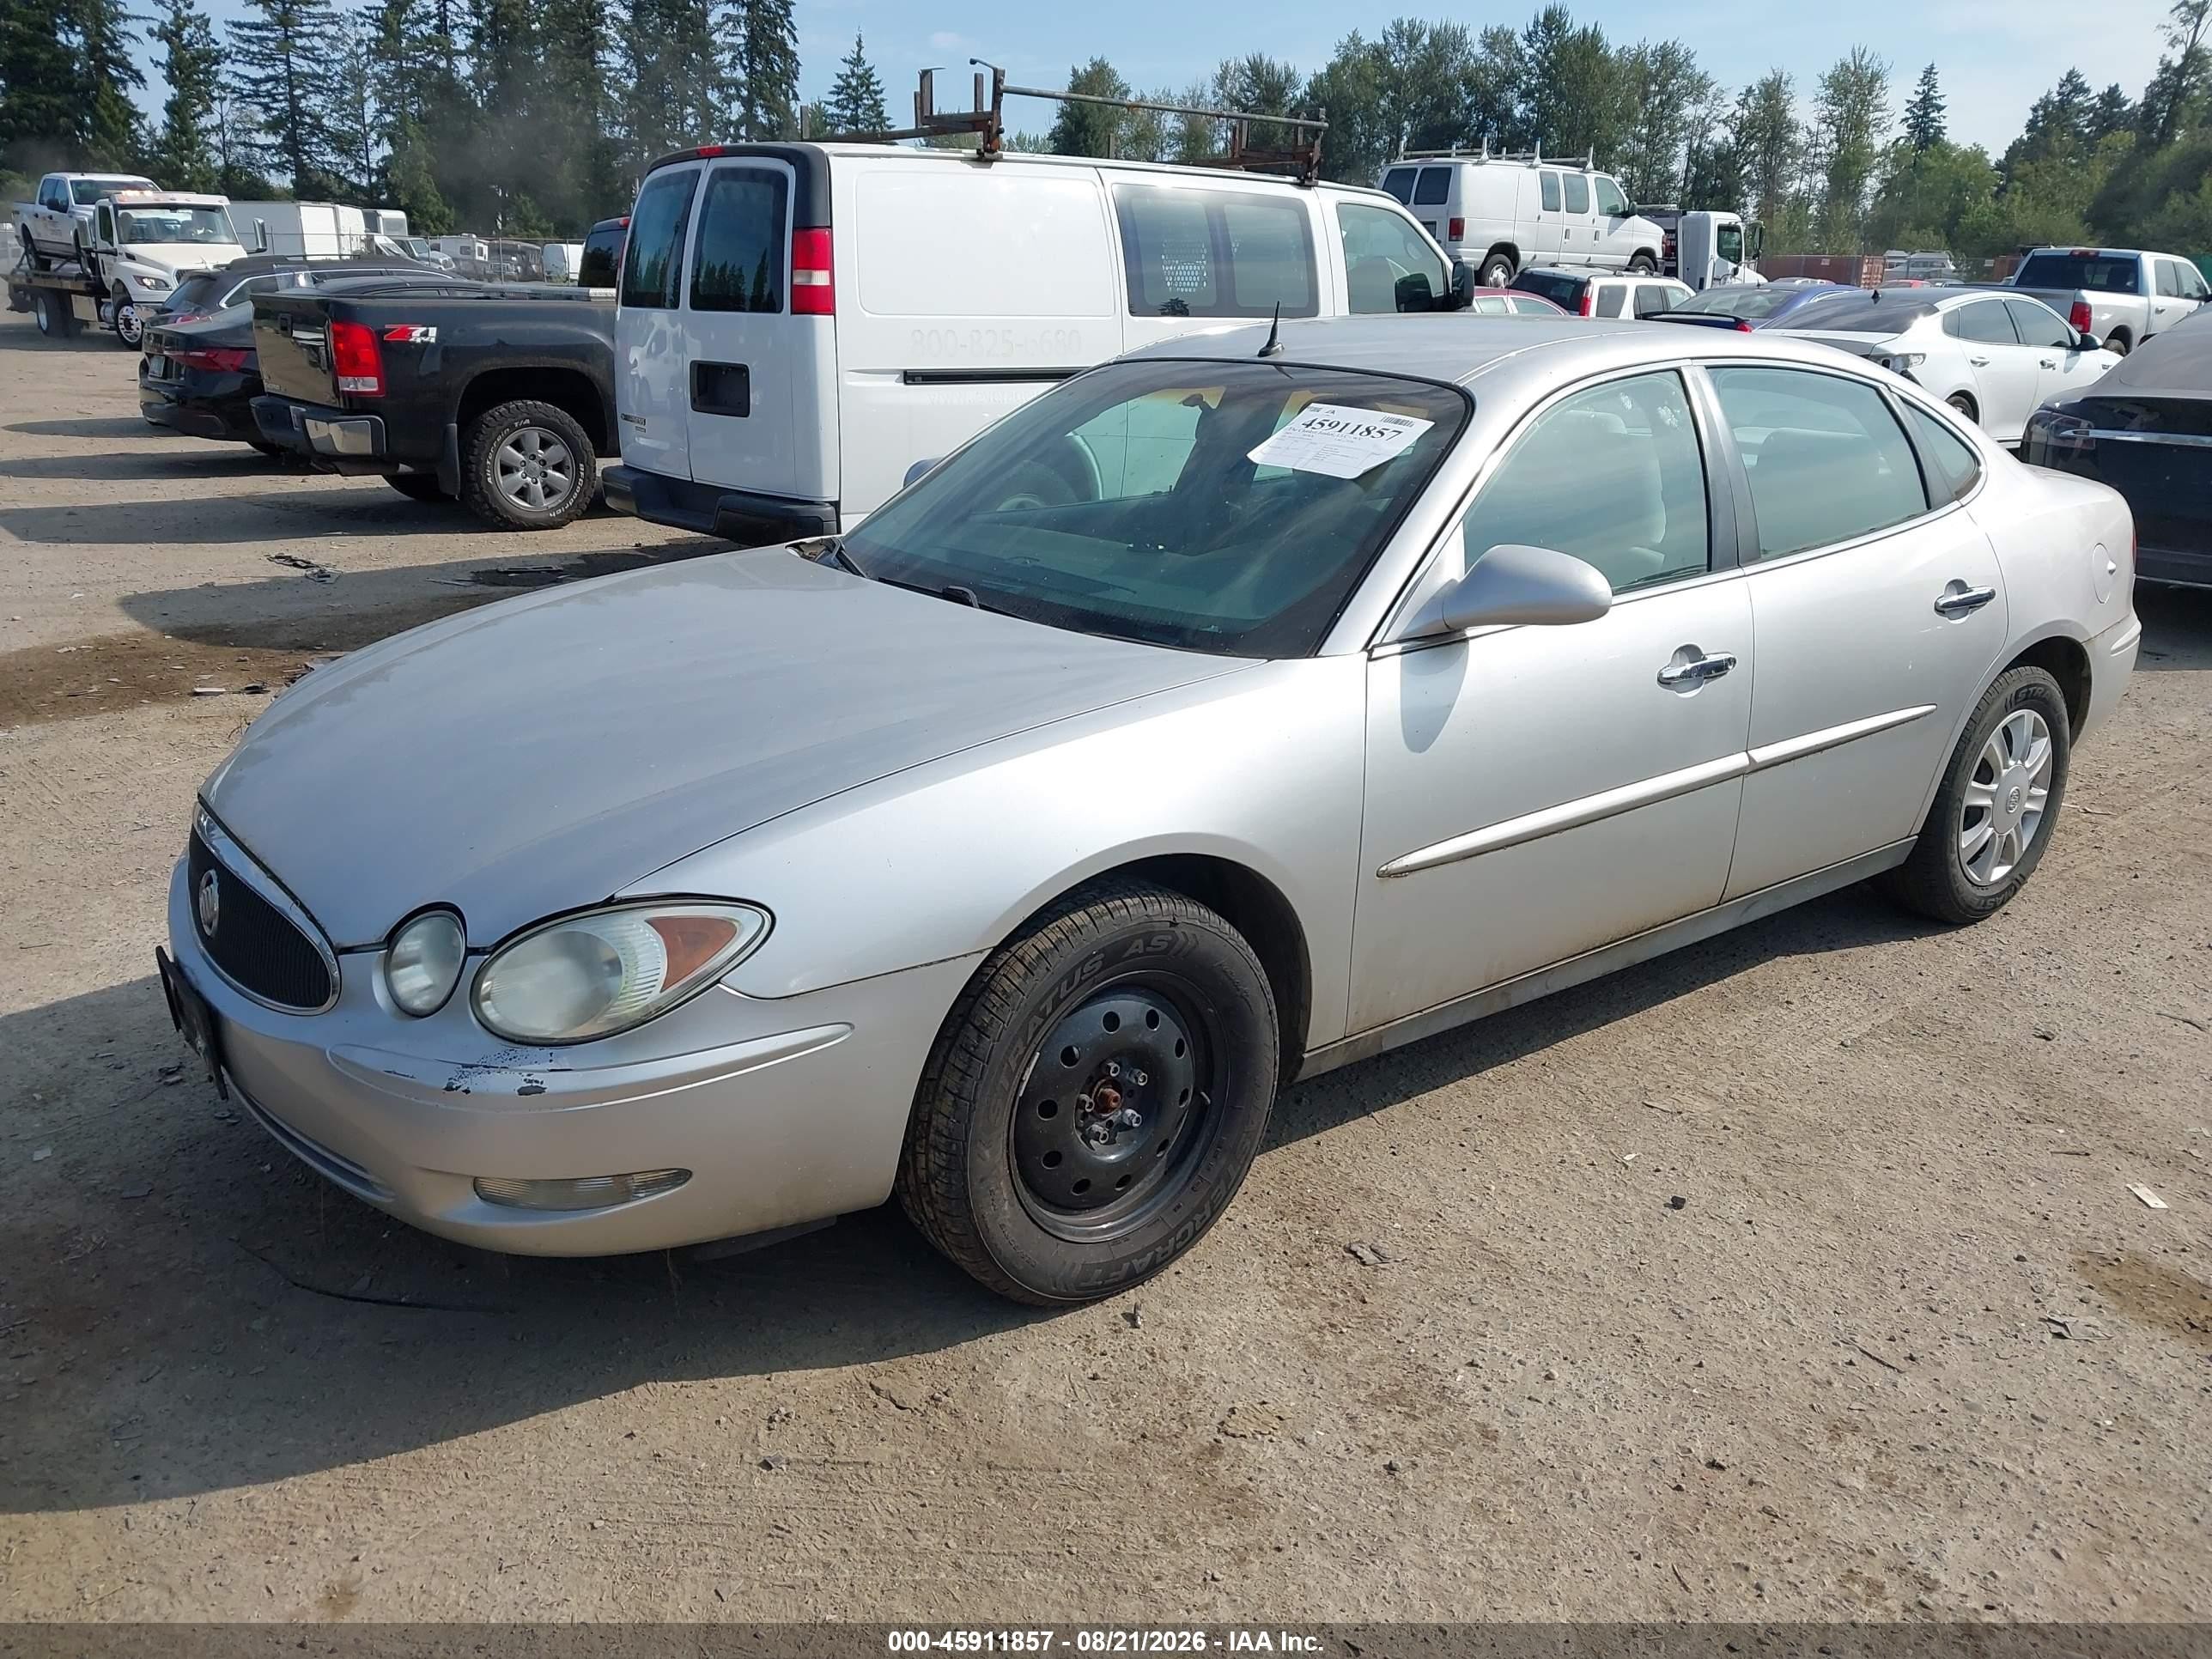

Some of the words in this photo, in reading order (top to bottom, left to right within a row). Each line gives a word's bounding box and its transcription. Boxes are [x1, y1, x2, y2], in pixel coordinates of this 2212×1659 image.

[384, 324, 437, 339] Z71
[1302, 417, 1404, 441] 45911857
[484, 427, 510, 485] All-Terrain
[514, 418, 532, 428] T/A
[549, 463, 586, 518] BFGoodrich
[1124, 933, 1174, 958] AS
